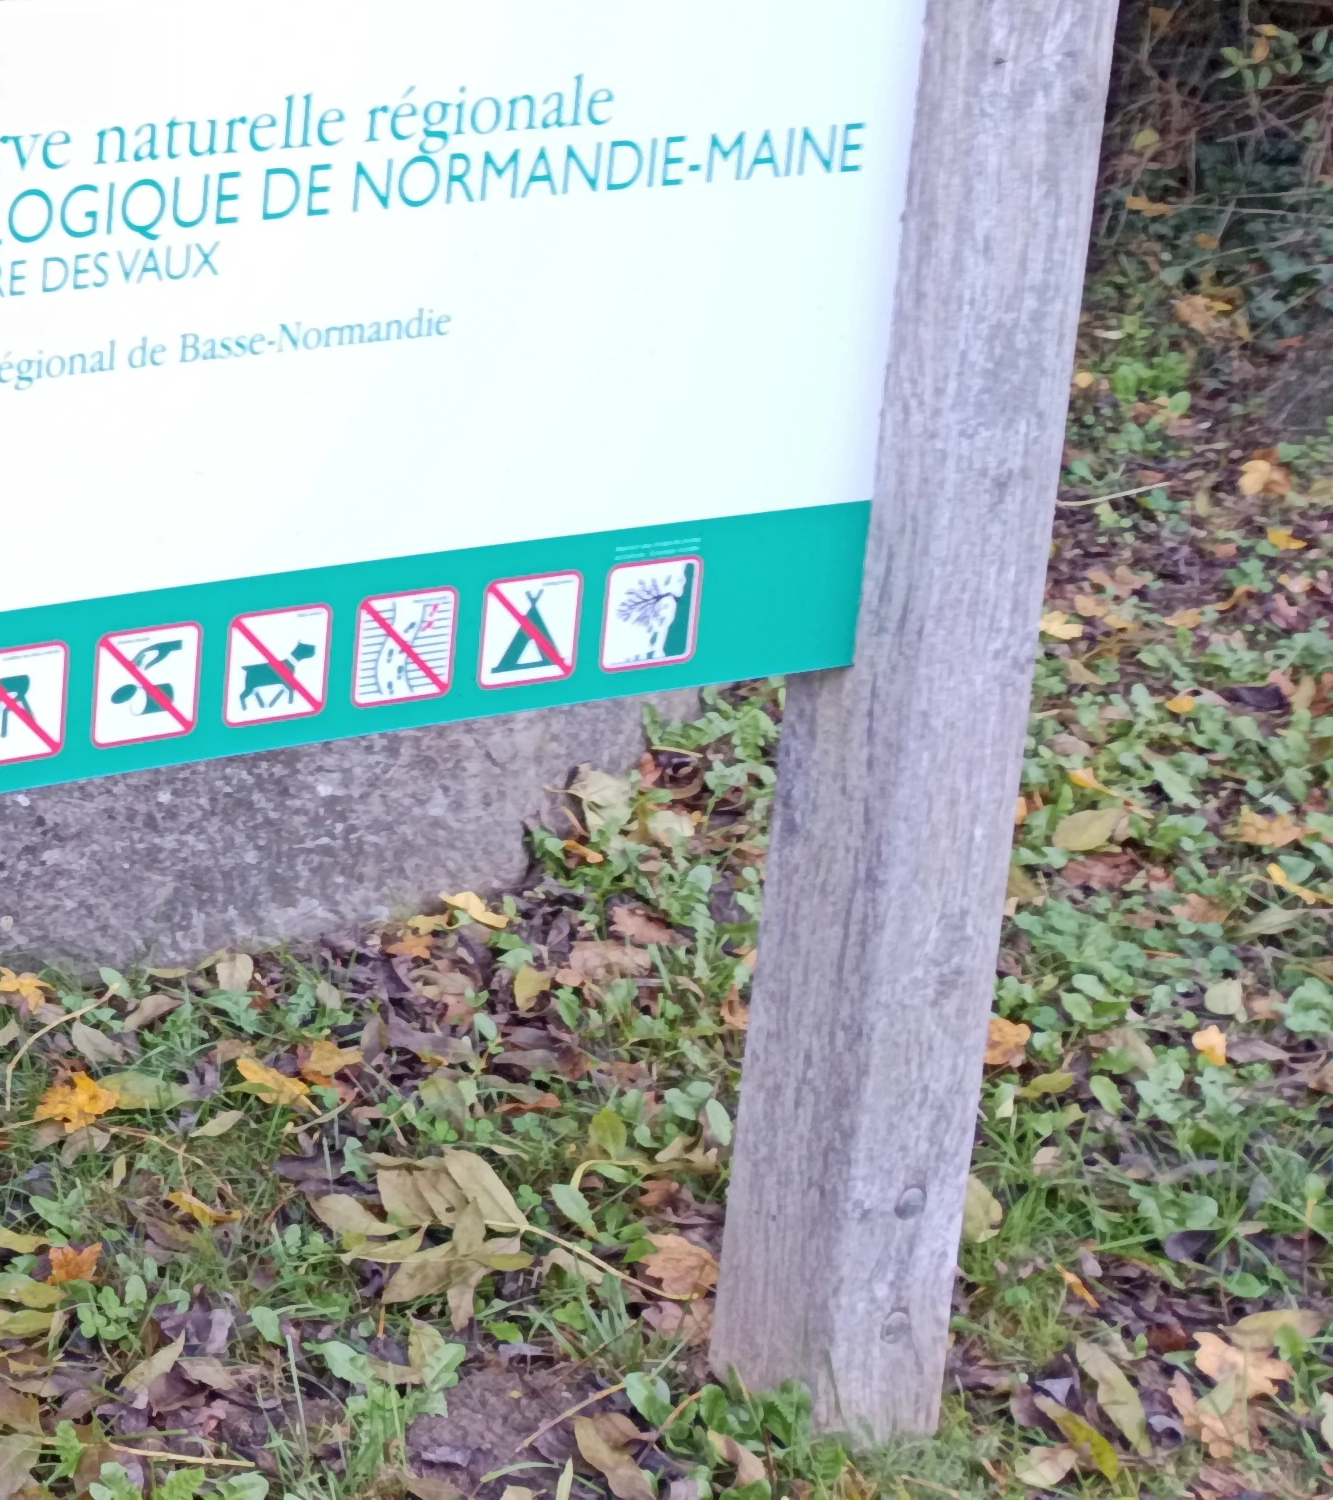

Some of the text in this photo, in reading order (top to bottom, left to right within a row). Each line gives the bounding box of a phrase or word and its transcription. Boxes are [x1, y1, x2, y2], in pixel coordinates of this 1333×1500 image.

[94, 92, 346, 165] naturelle
[365, 73, 615, 154] régionale
[261, 163, 333, 221] DE
[352, 122, 867, 212] NORMANDIE-MAINE
[41, 252, 109, 293] DES
[117, 241, 220, 283] VAUX
[128, 336, 167, 369] de
[179, 308, 452, 363] Basse-Normandie
